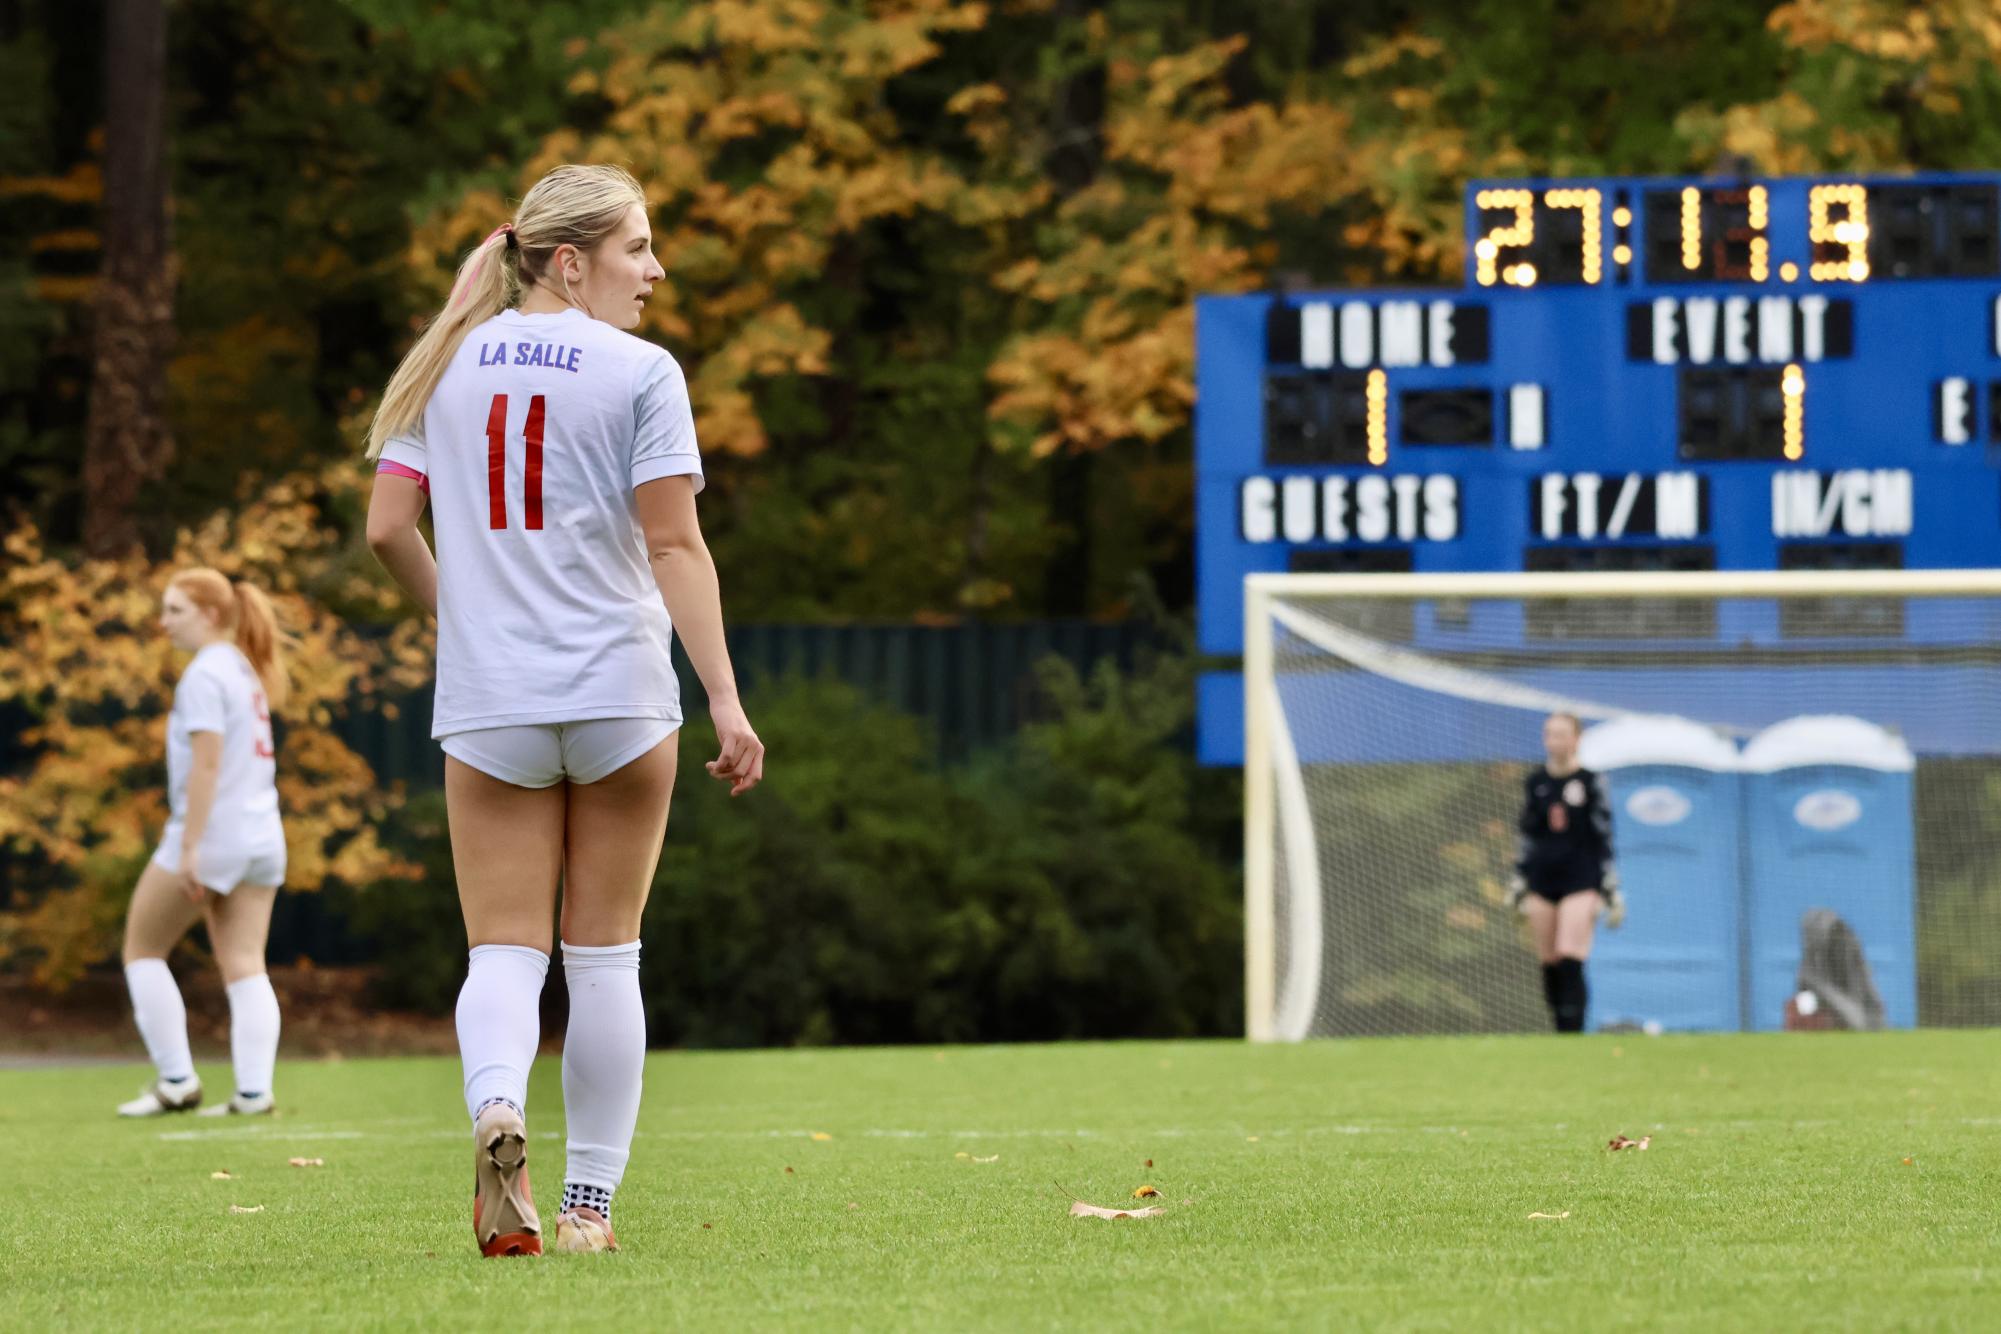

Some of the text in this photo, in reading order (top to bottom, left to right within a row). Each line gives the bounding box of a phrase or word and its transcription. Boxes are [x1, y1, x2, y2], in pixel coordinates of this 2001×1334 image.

[479, 342, 583, 373] LA SALLE
[1301, 300, 1456, 369] HOME
[1652, 295, 1828, 365] EVENT
[1942, 376, 1970, 445] E
[486, 394, 545, 530] 11
[1243, 473, 1458, 544] GUESTS
